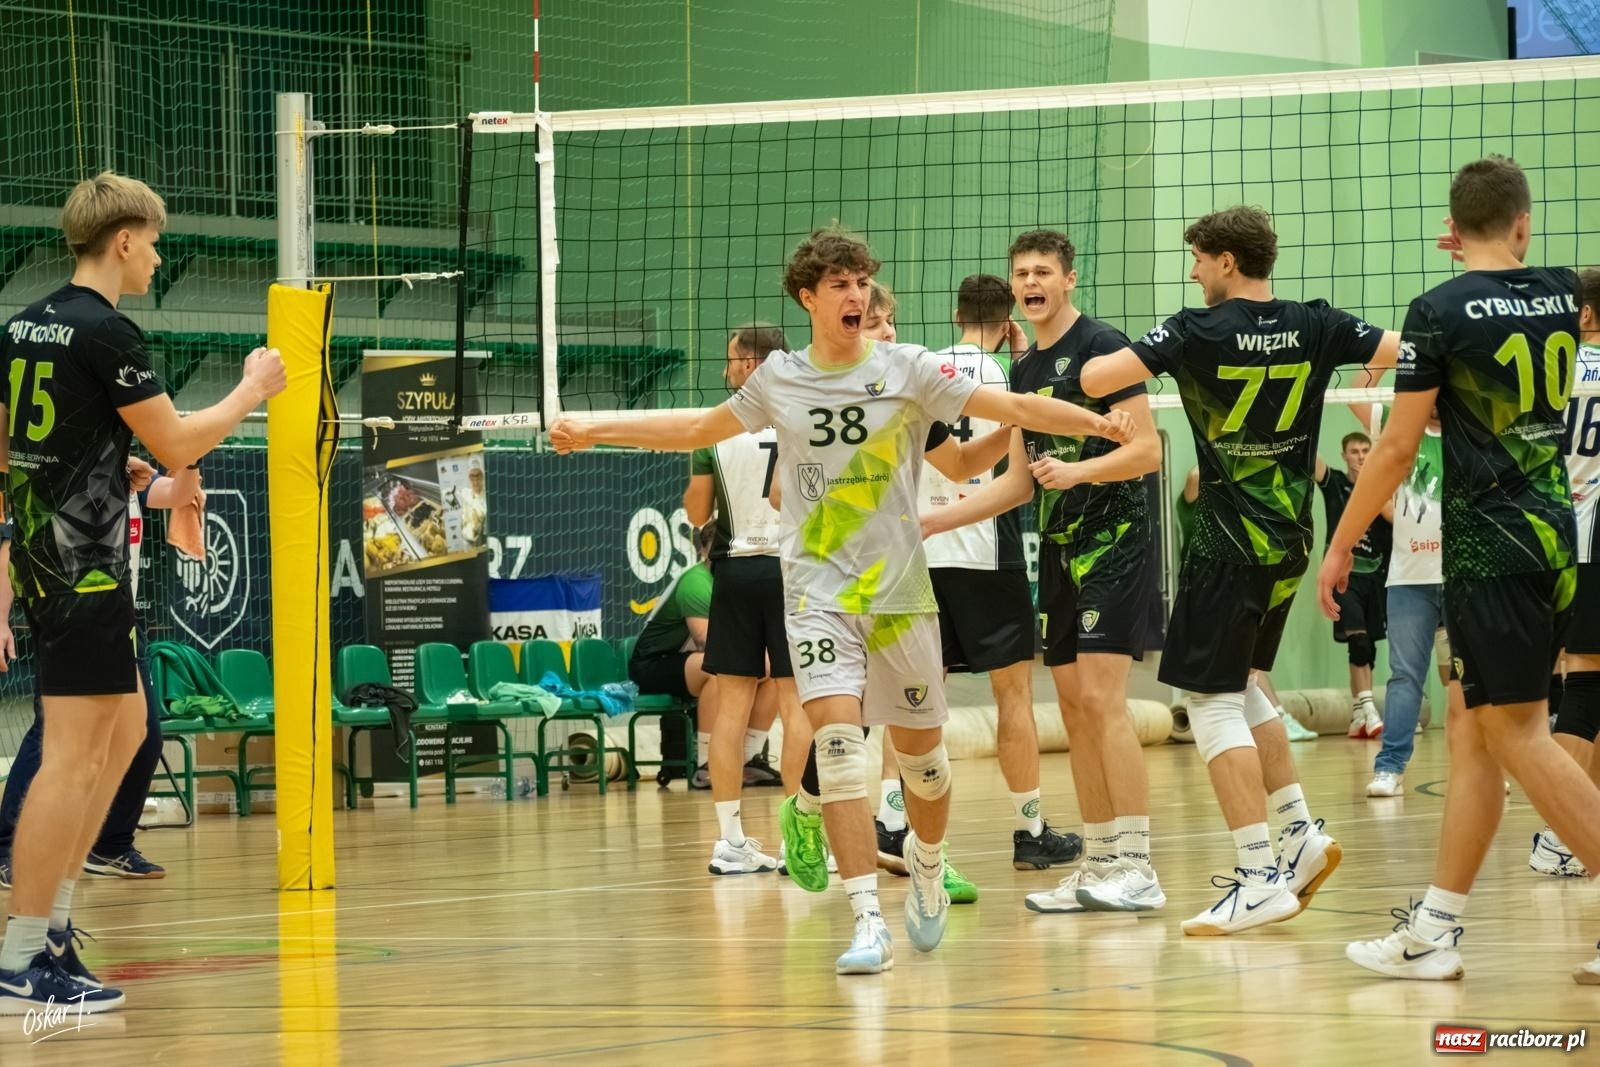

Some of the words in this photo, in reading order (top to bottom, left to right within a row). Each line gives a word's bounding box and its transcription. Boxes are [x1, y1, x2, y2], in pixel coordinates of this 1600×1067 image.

[481, 117, 508, 125] netex
[1465, 295, 1565, 319] CYBULSKI
[1236, 331, 1300, 355] WIĘZIK
[1494, 331, 1576, 412] 10
[8, 358, 56, 442] 15
[1217, 361, 1312, 432] 77
[469, 419, 498, 428] netex
[502, 415, 529, 426] KSR
[808, 406, 868, 447] 38
[490, 624, 548, 640] KASA
[797, 638, 836, 668] 38
